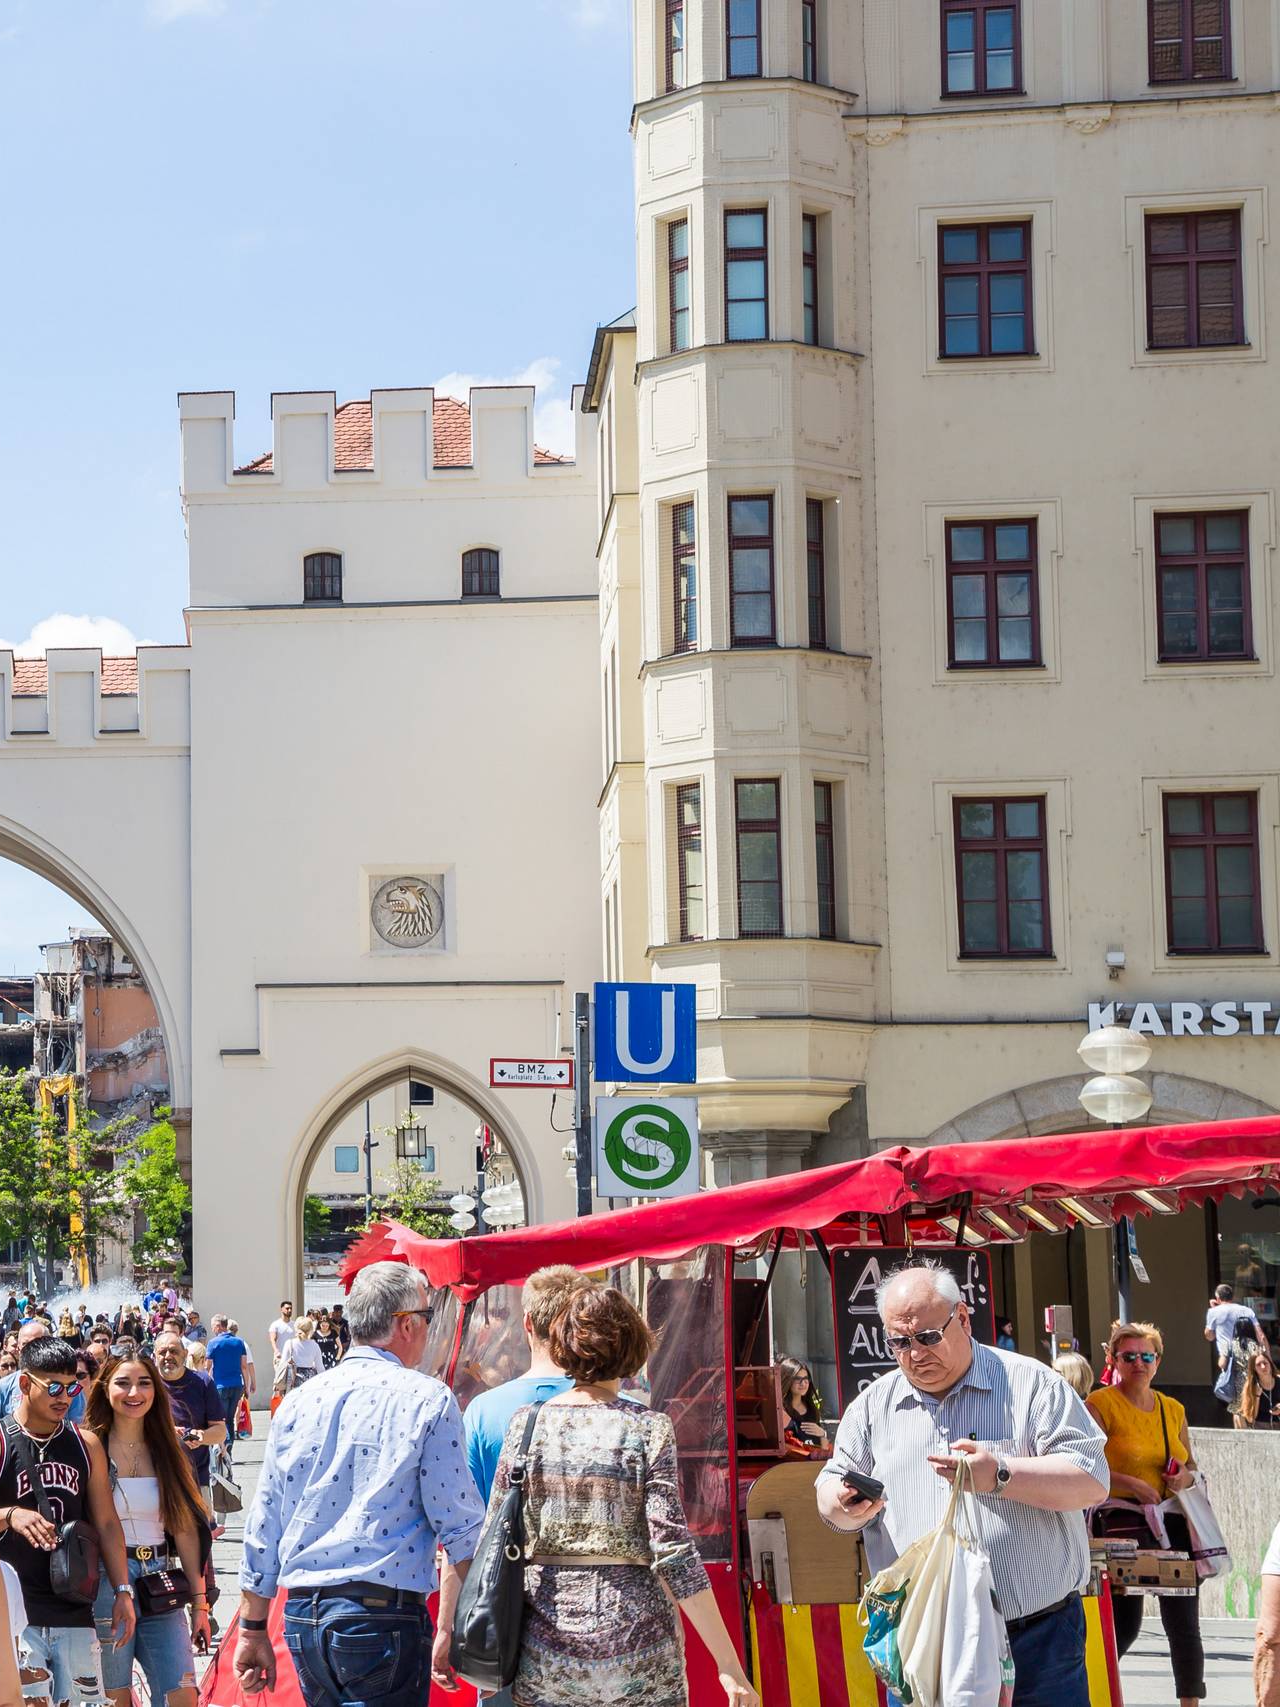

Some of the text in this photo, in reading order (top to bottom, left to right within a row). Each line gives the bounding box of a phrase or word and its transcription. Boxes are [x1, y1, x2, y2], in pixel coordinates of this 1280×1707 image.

[615, 990, 676, 1075] U
[1087, 1001, 1280, 1036] KARST
[517, 1064, 545, 1074] BMZ
[620, 1113, 675, 1180] S
[17, 1462, 79, 1499] BONX
